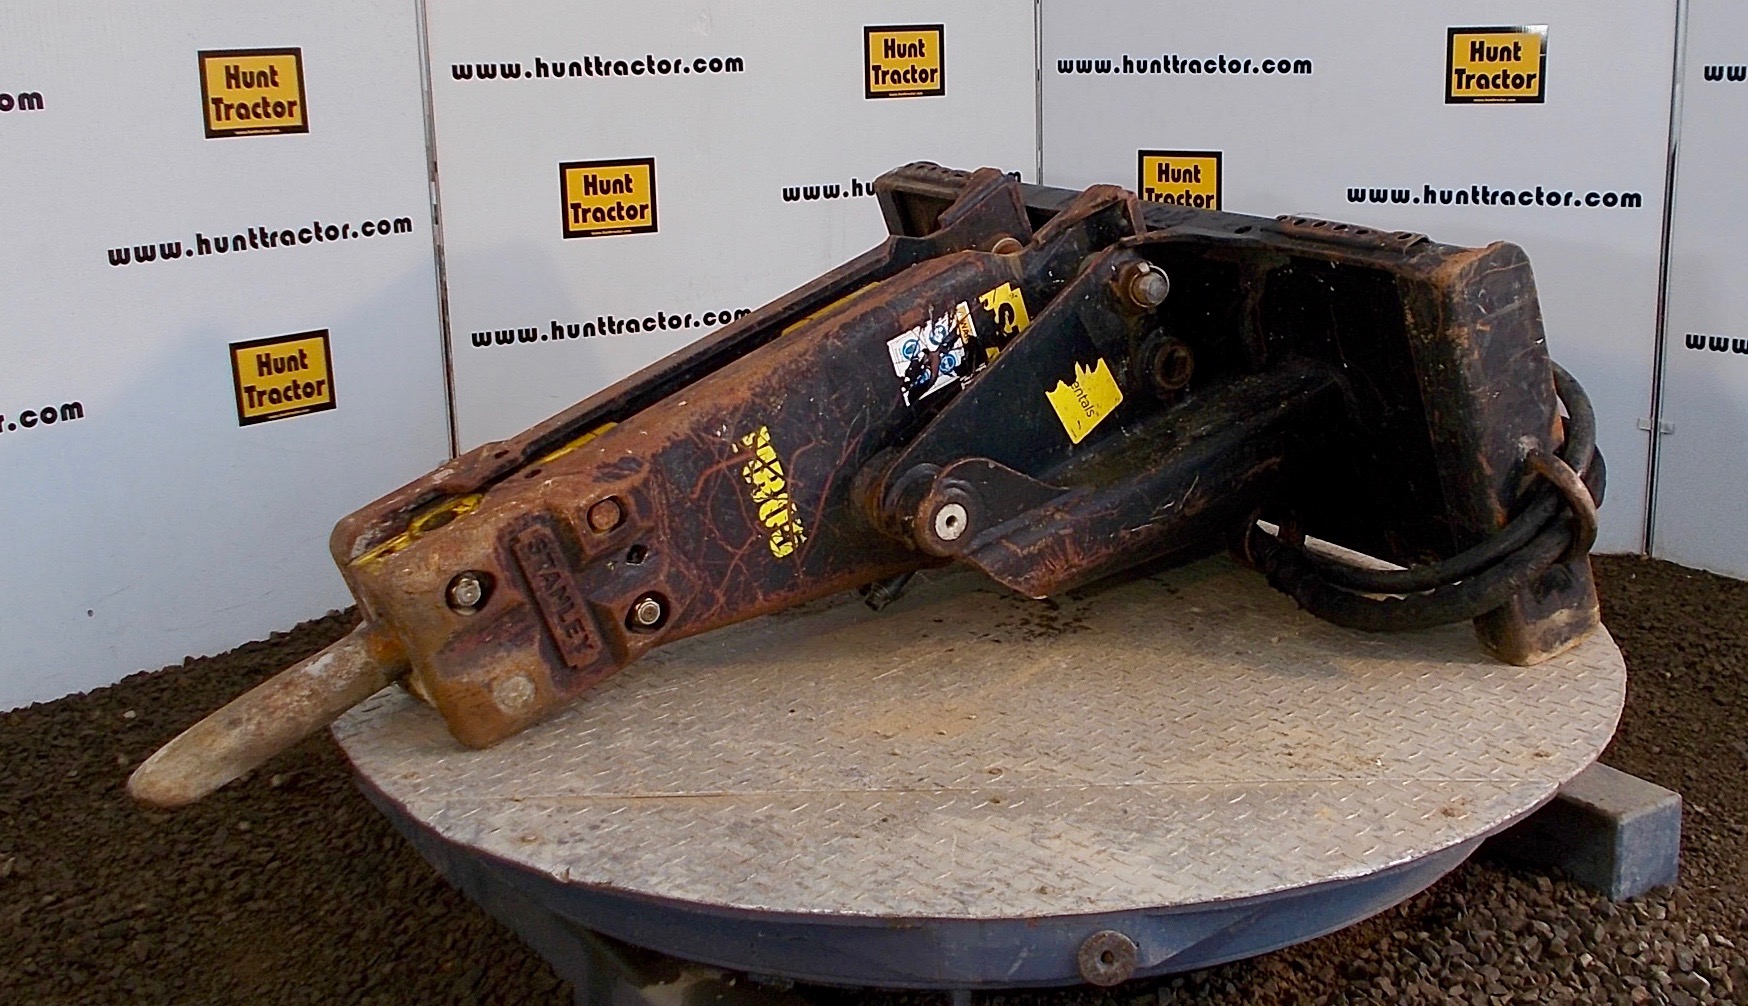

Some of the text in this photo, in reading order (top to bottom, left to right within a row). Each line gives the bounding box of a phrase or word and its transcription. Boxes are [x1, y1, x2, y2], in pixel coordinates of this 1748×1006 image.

[883, 38, 926, 58] Hunt
[1469, 40, 1522, 62] Hunt
[452, 55, 743, 80] www.hunttractor.com
[871, 65, 939, 85] Tractor
[1058, 55, 1312, 75] www.hunttractor.com
[1704, 66, 1748, 82] ww
[225, 65, 280, 89] Hunt
[1454, 68, 1537, 90] Tractor
[0, 92, 44, 111] om
[210, 97, 298, 122] Tractor
[1157, 162, 1201, 183] Hunt
[583, 173, 633, 196] Hunt
[783, 178, 876, 202] www.hu
[1348, 185, 1641, 207] www.hunttractor.com
[1145, 187, 1215, 209] Tractor
[570, 201, 649, 224] Tractor
[108, 218, 412, 266] www.hunttractor.com
[1685, 334, 1748, 355] www
[256, 348, 308, 377] Hunt
[243, 379, 326, 409] Tractor
[1071, 381, 1095, 418] entals
[0, 402, 84, 433] .com
[527, 536, 595, 655] STANLEY
